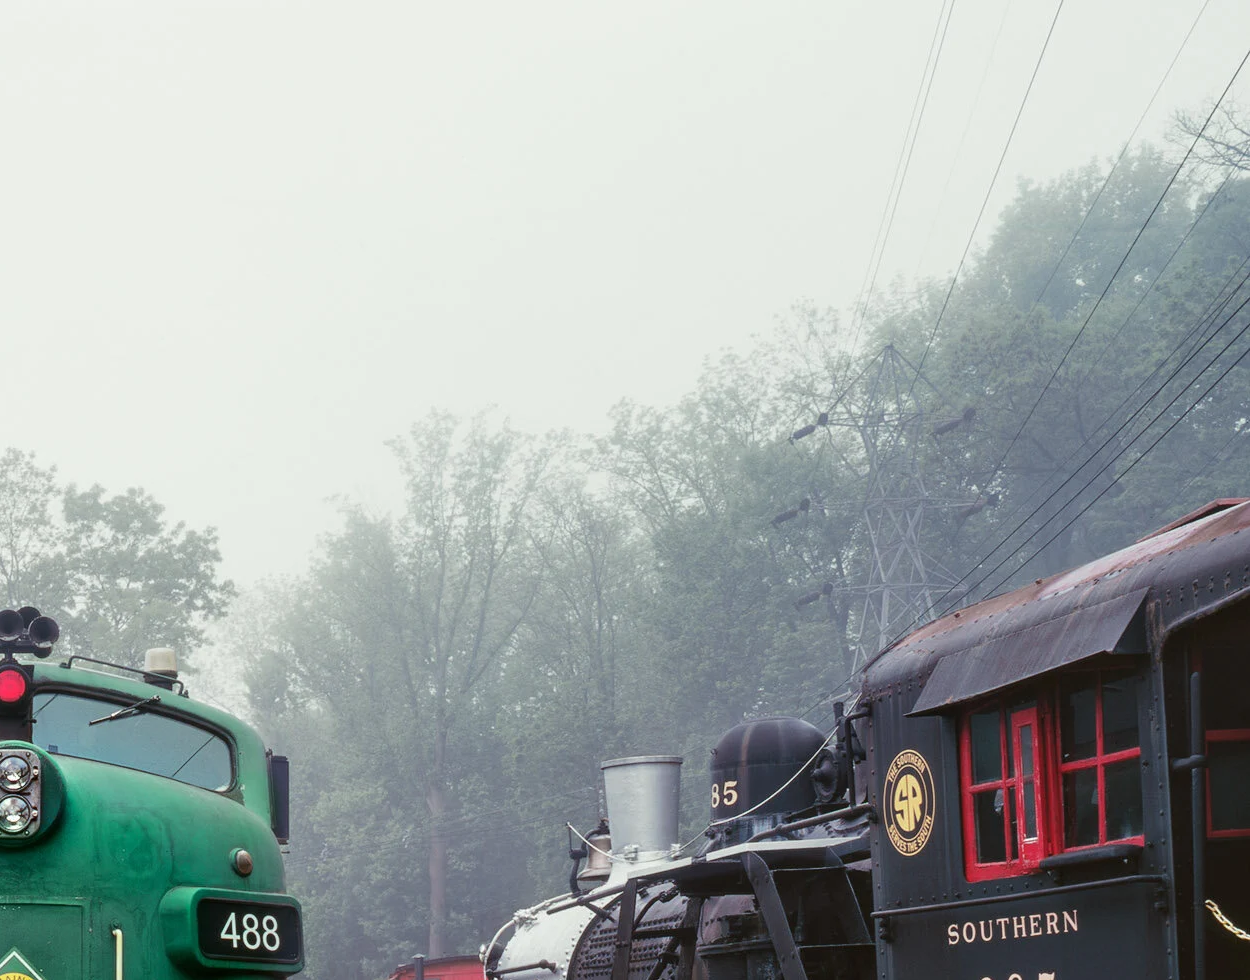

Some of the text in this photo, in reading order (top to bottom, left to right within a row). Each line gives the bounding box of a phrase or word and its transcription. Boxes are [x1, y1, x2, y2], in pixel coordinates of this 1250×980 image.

[888, 753, 925, 782] THE SOUTHERN
[894, 774, 922, 832] SR
[888, 815, 932, 853] SERVES THE SOUTH
[220, 912, 280, 951] 488
[947, 909, 1078, 945] SOUTHERN
